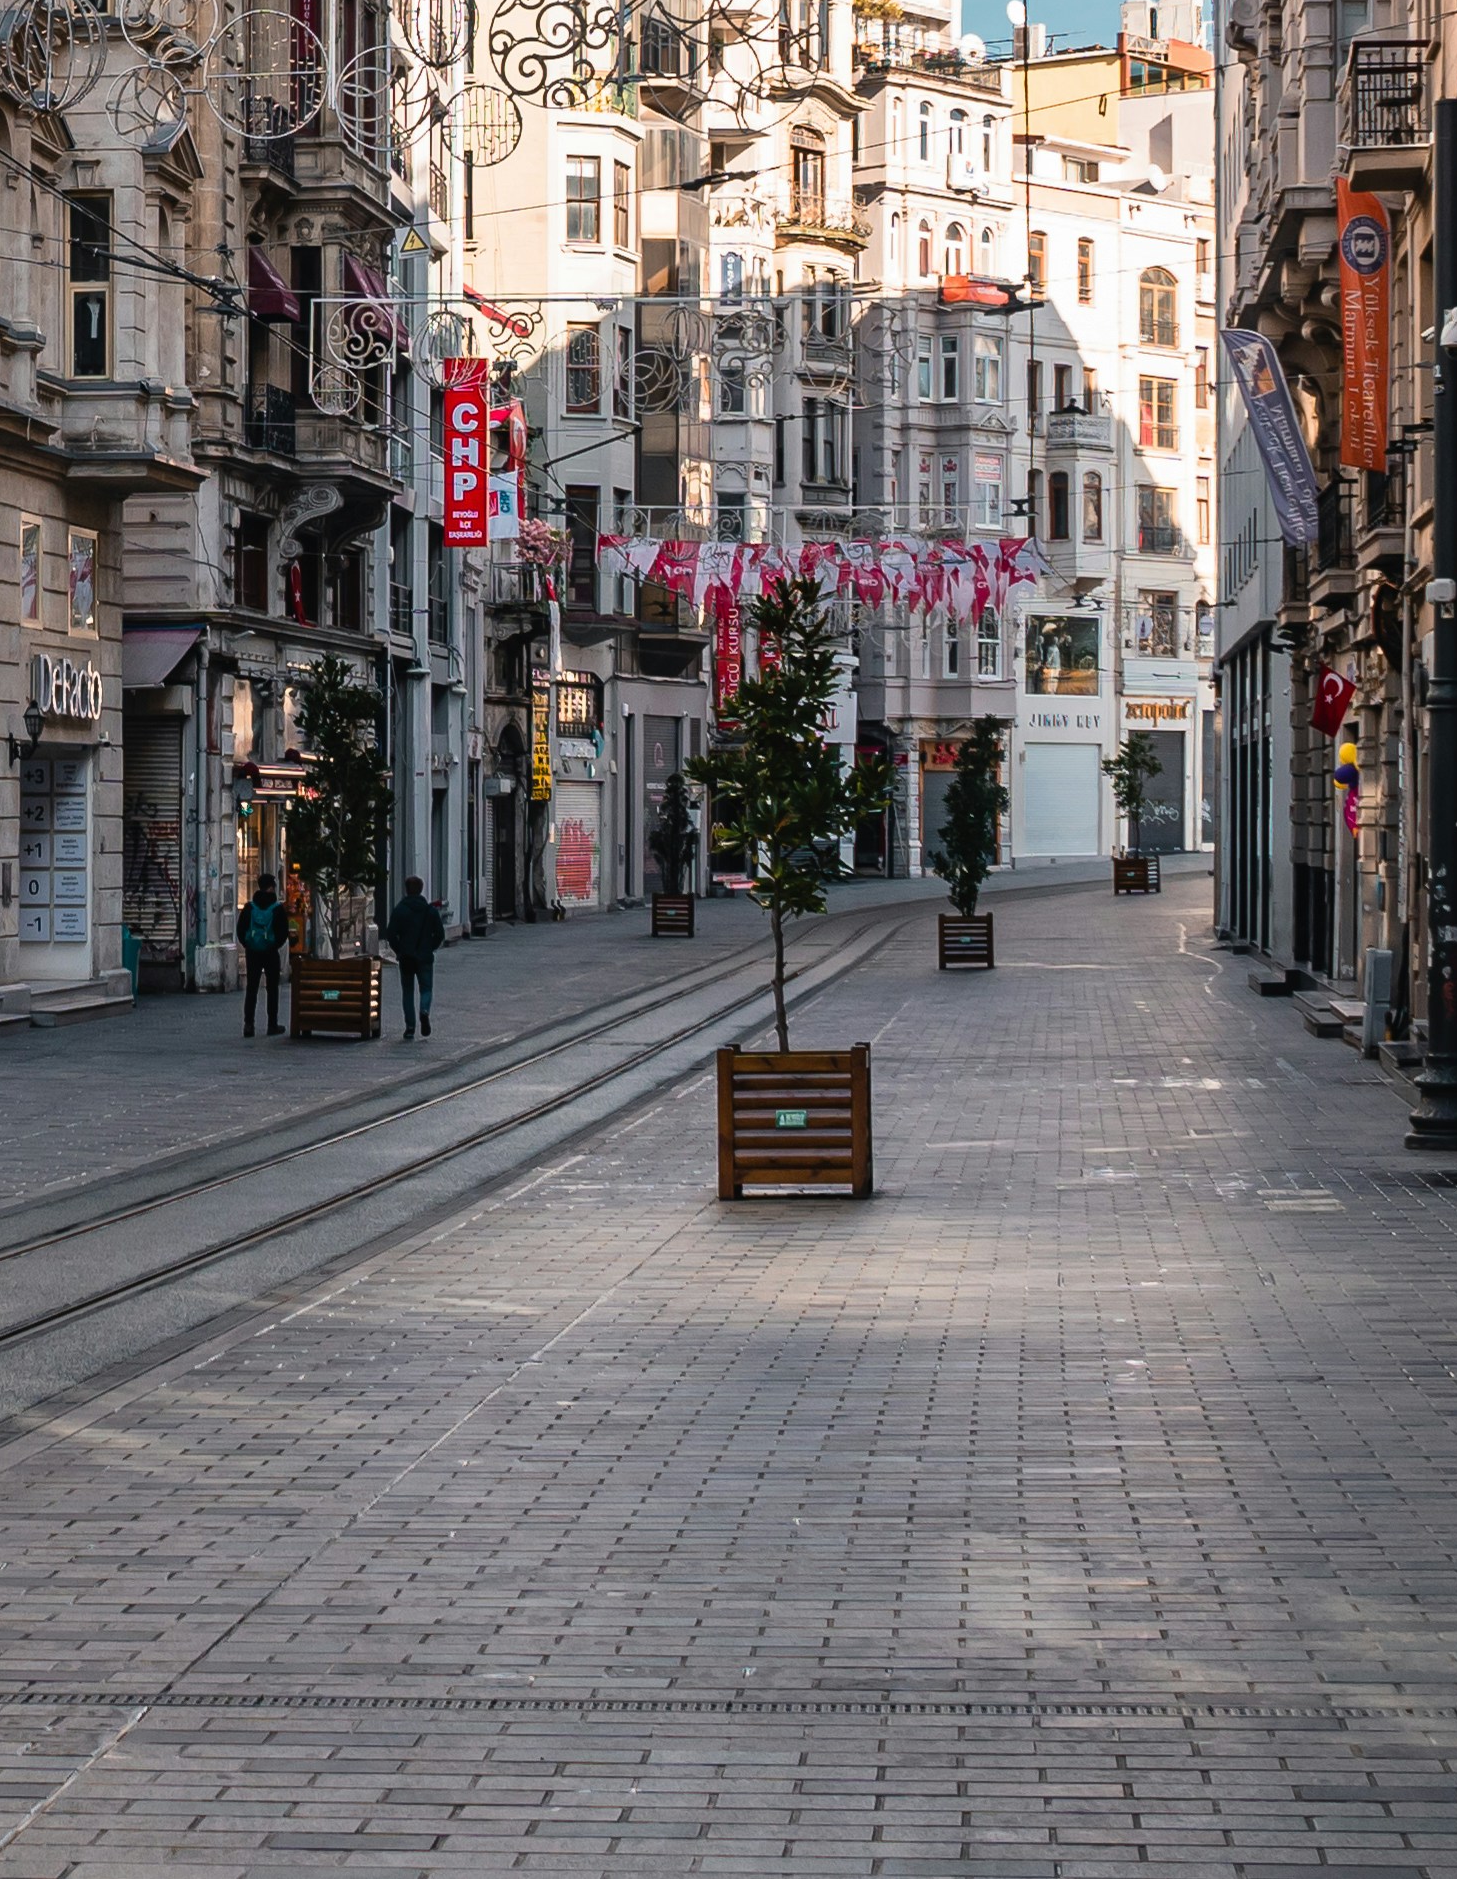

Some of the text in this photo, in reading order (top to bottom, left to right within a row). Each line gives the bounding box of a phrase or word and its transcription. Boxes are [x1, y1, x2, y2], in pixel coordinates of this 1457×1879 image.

[1344, 289, 1362, 379] Marmara
[1362, 276, 1380, 467] Yüksek Ticaretliler
[452, 403, 479, 501] CHP
[499, 490, 511, 513] CHP
[728, 608, 739, 654] KURSU
[38, 653, 103, 721] DeFacto
[23, 768, 44, 784] +3
[23, 805, 44, 821] +2
[23, 842, 42, 858] +1
[28, 879, 40, 895] 0
[26, 916, 42, 932] -1
